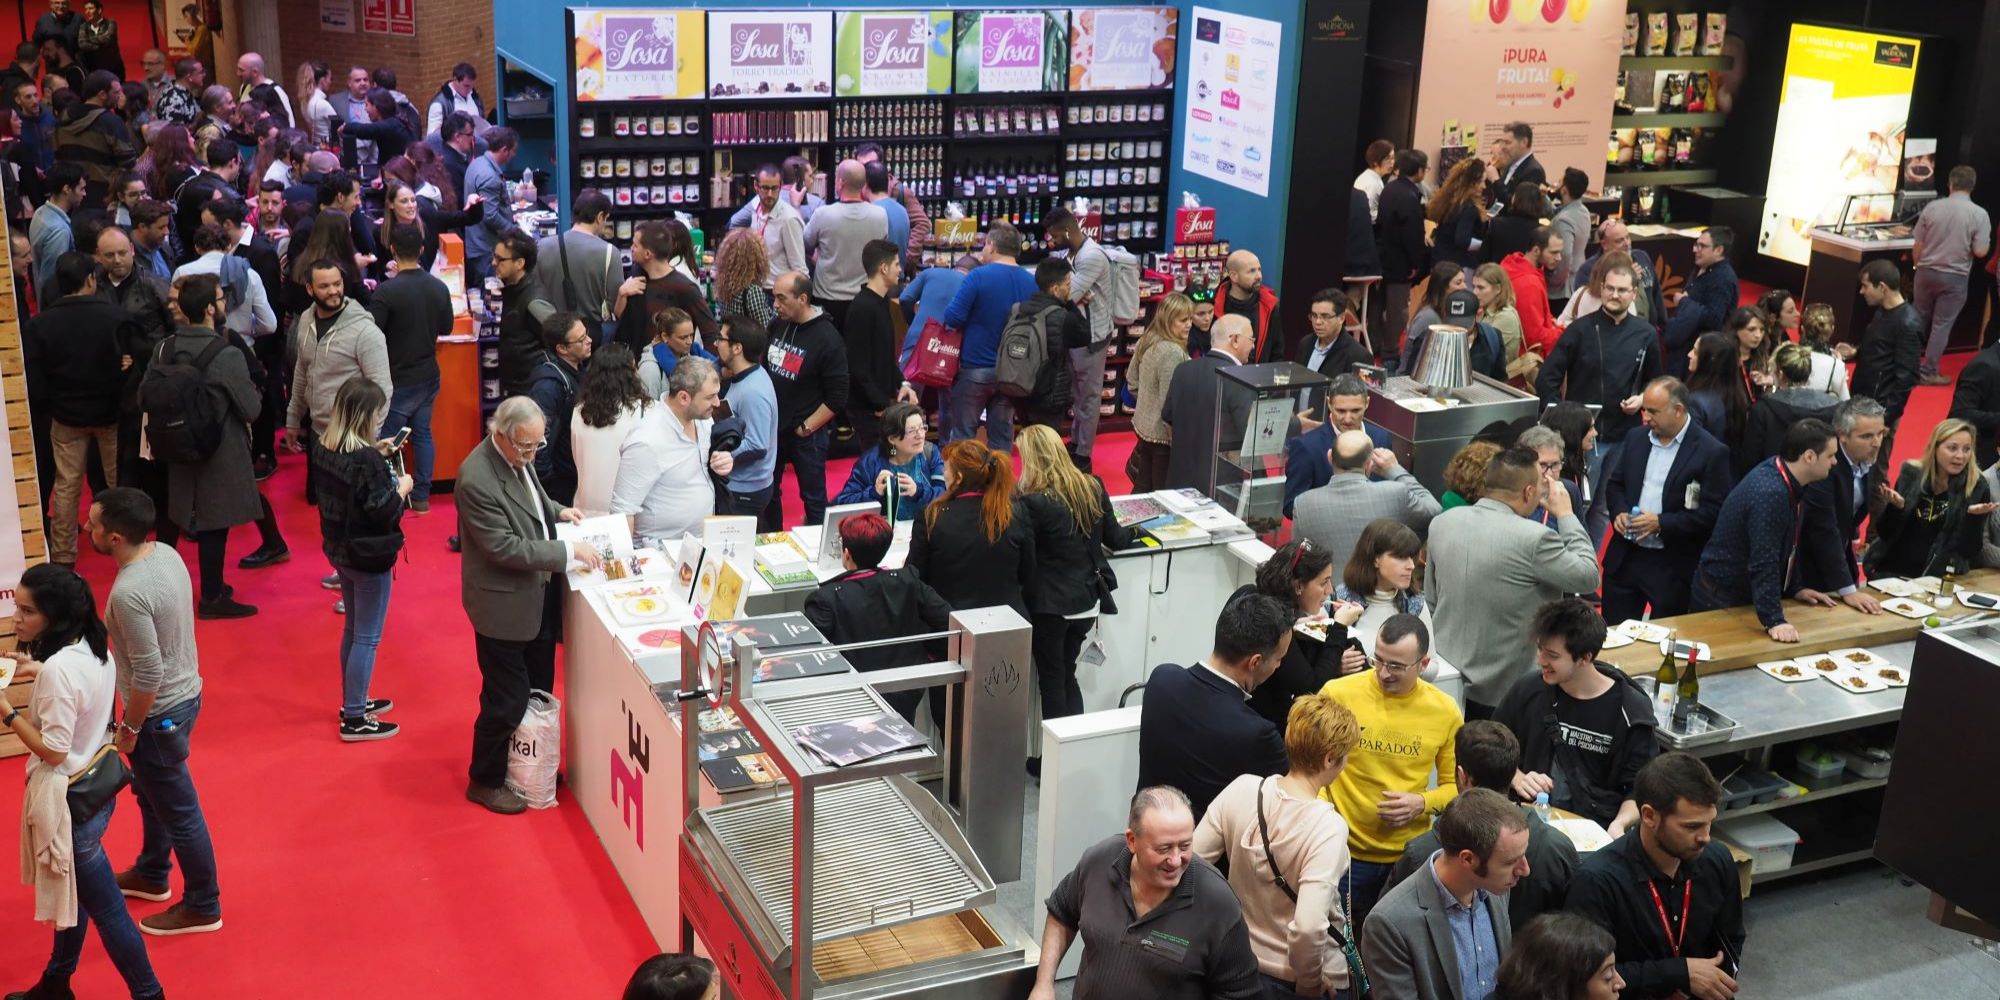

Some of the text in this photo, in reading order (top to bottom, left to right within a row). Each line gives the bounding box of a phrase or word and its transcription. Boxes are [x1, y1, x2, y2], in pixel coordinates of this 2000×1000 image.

[606, 28, 668, 71] Sosa
[731, 28, 780, 63] Sosa
[863, 28, 920, 69] Sosa
[983, 27, 1036, 66] Sosa
[1096, 25, 1146, 62] Sosa
[1497, 67, 1550, 85] FRUTA!
[944, 222, 975, 245] Sosa
[1181, 211, 1214, 234] Sosa
[773, 338, 804, 356] TOMMY
[1359, 738, 1420, 756] PARADOX
[1570, 730, 1593, 743] MAESTRO
